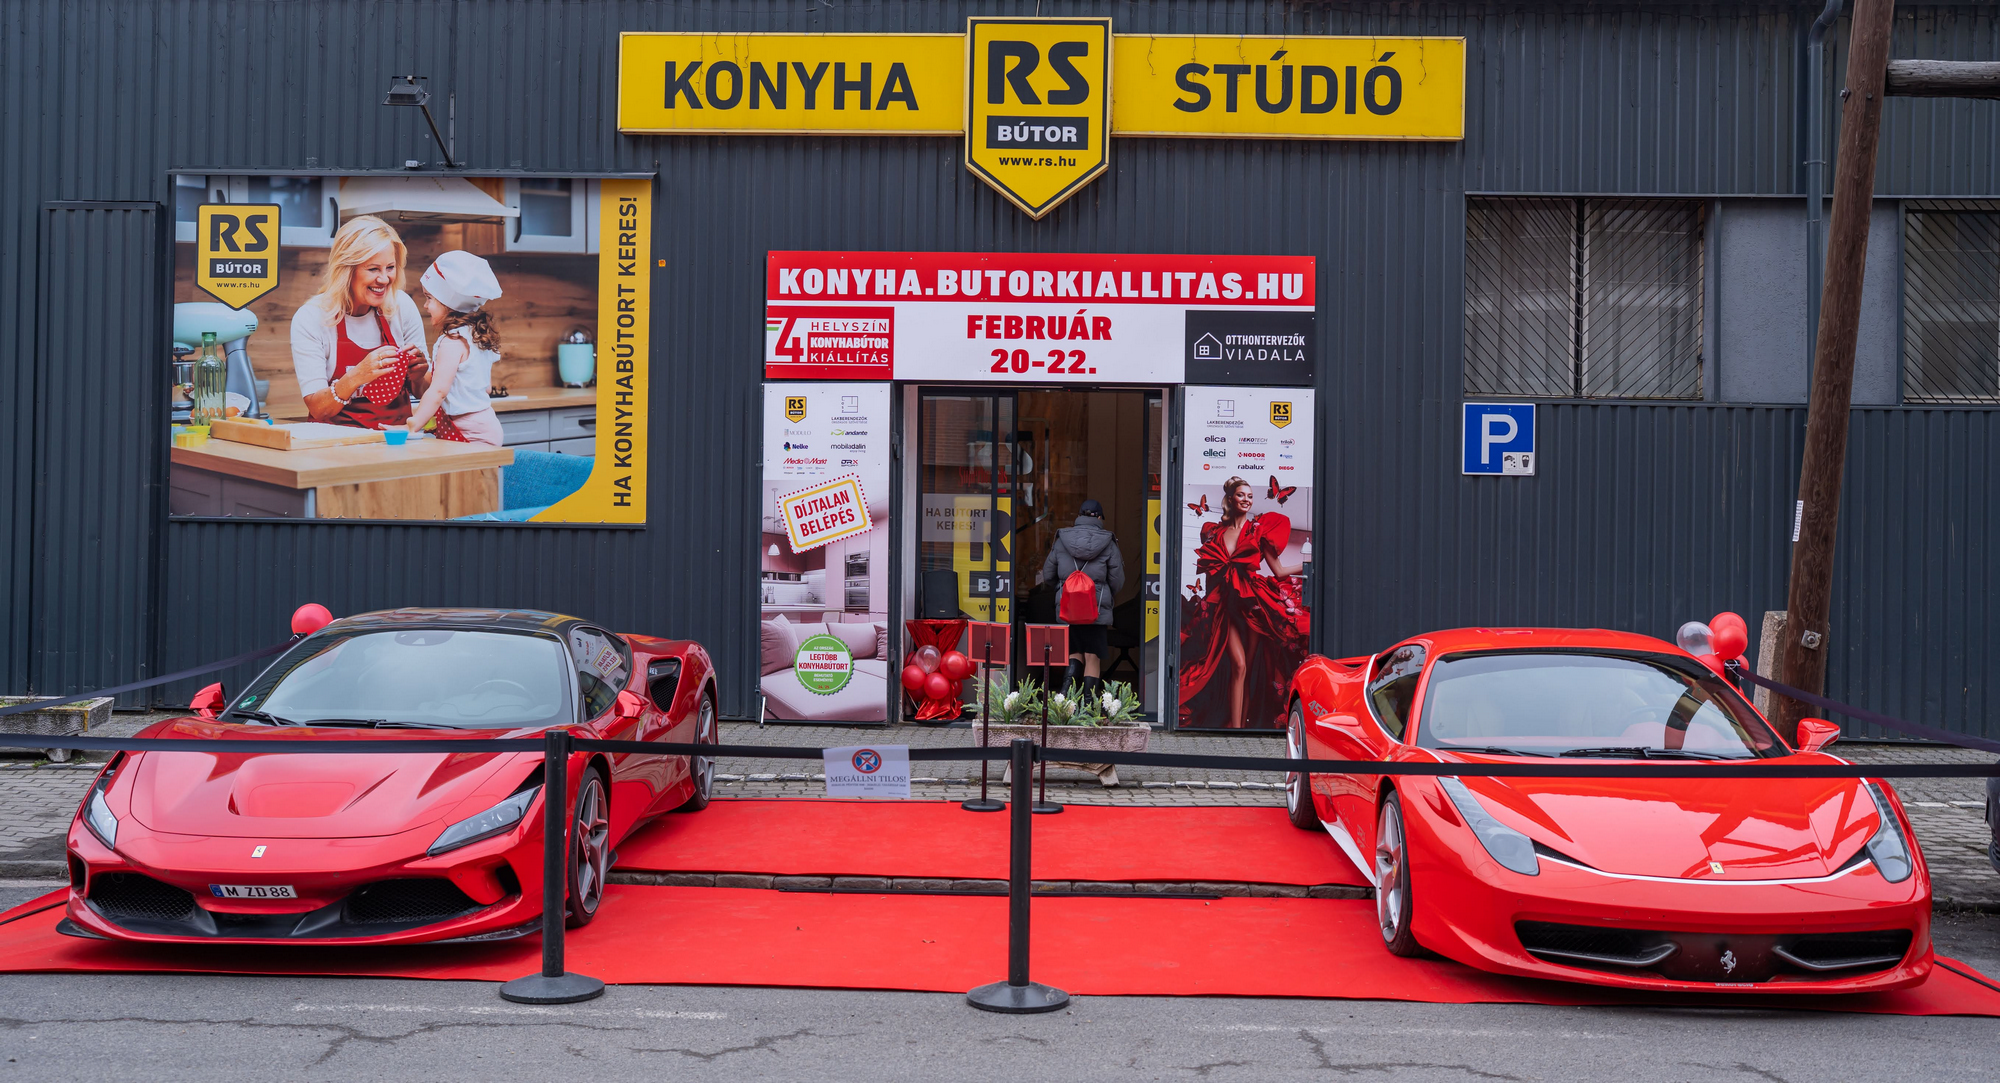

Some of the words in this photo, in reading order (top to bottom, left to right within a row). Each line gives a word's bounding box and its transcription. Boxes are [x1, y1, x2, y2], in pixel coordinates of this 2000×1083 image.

[987, 40, 1090, 105] RS
[664, 60, 919, 110] KONYHA
[1173, 50, 1402, 115] STÚDIÓ
[997, 121, 1077, 142] BÚTOR
[999, 156, 1076, 166] www.rs.hu
[210, 214, 269, 252] RS
[618, 197, 637, 276] KERES!
[215, 262, 262, 274] BÚTOR
[779, 268, 1303, 300] KONYHA.BUTORKIALLITAS.HU
[811, 320, 887, 331] HELYSZÍN
[967, 309, 1112, 340] FEBRUÁR
[775, 318, 804, 362] 4
[810, 335, 889, 349] KONYHABÚTOR
[1225, 333, 1305, 346] OTTHONTERVEZŐK
[810, 351, 889, 363] KIÁLLÍTÁS
[991, 348, 1096, 374] 20-22.
[1225, 348, 1305, 361] VIADALA
[612, 284, 635, 467] KONYHABÚTORT
[788, 399, 804, 409] RS
[1273, 404, 1289, 415] RS
[1481, 414, 1518, 464] P
[1203, 448, 1226, 457] elleci
[613, 475, 631, 507] HA
[794, 490, 850, 519] DÍJTALAN
[925, 508, 941, 517] HA
[800, 507, 855, 537] BELÉPÉS
[936, 521, 976, 530] KERES!
[809, 652, 837, 661] LEGTÖBB
[798, 661, 848, 670] KONYHABÚTORT
[830, 775, 877, 783] MEGÁLLNI
[225, 886, 239, 896] M
[269, 887, 290, 897] 88
